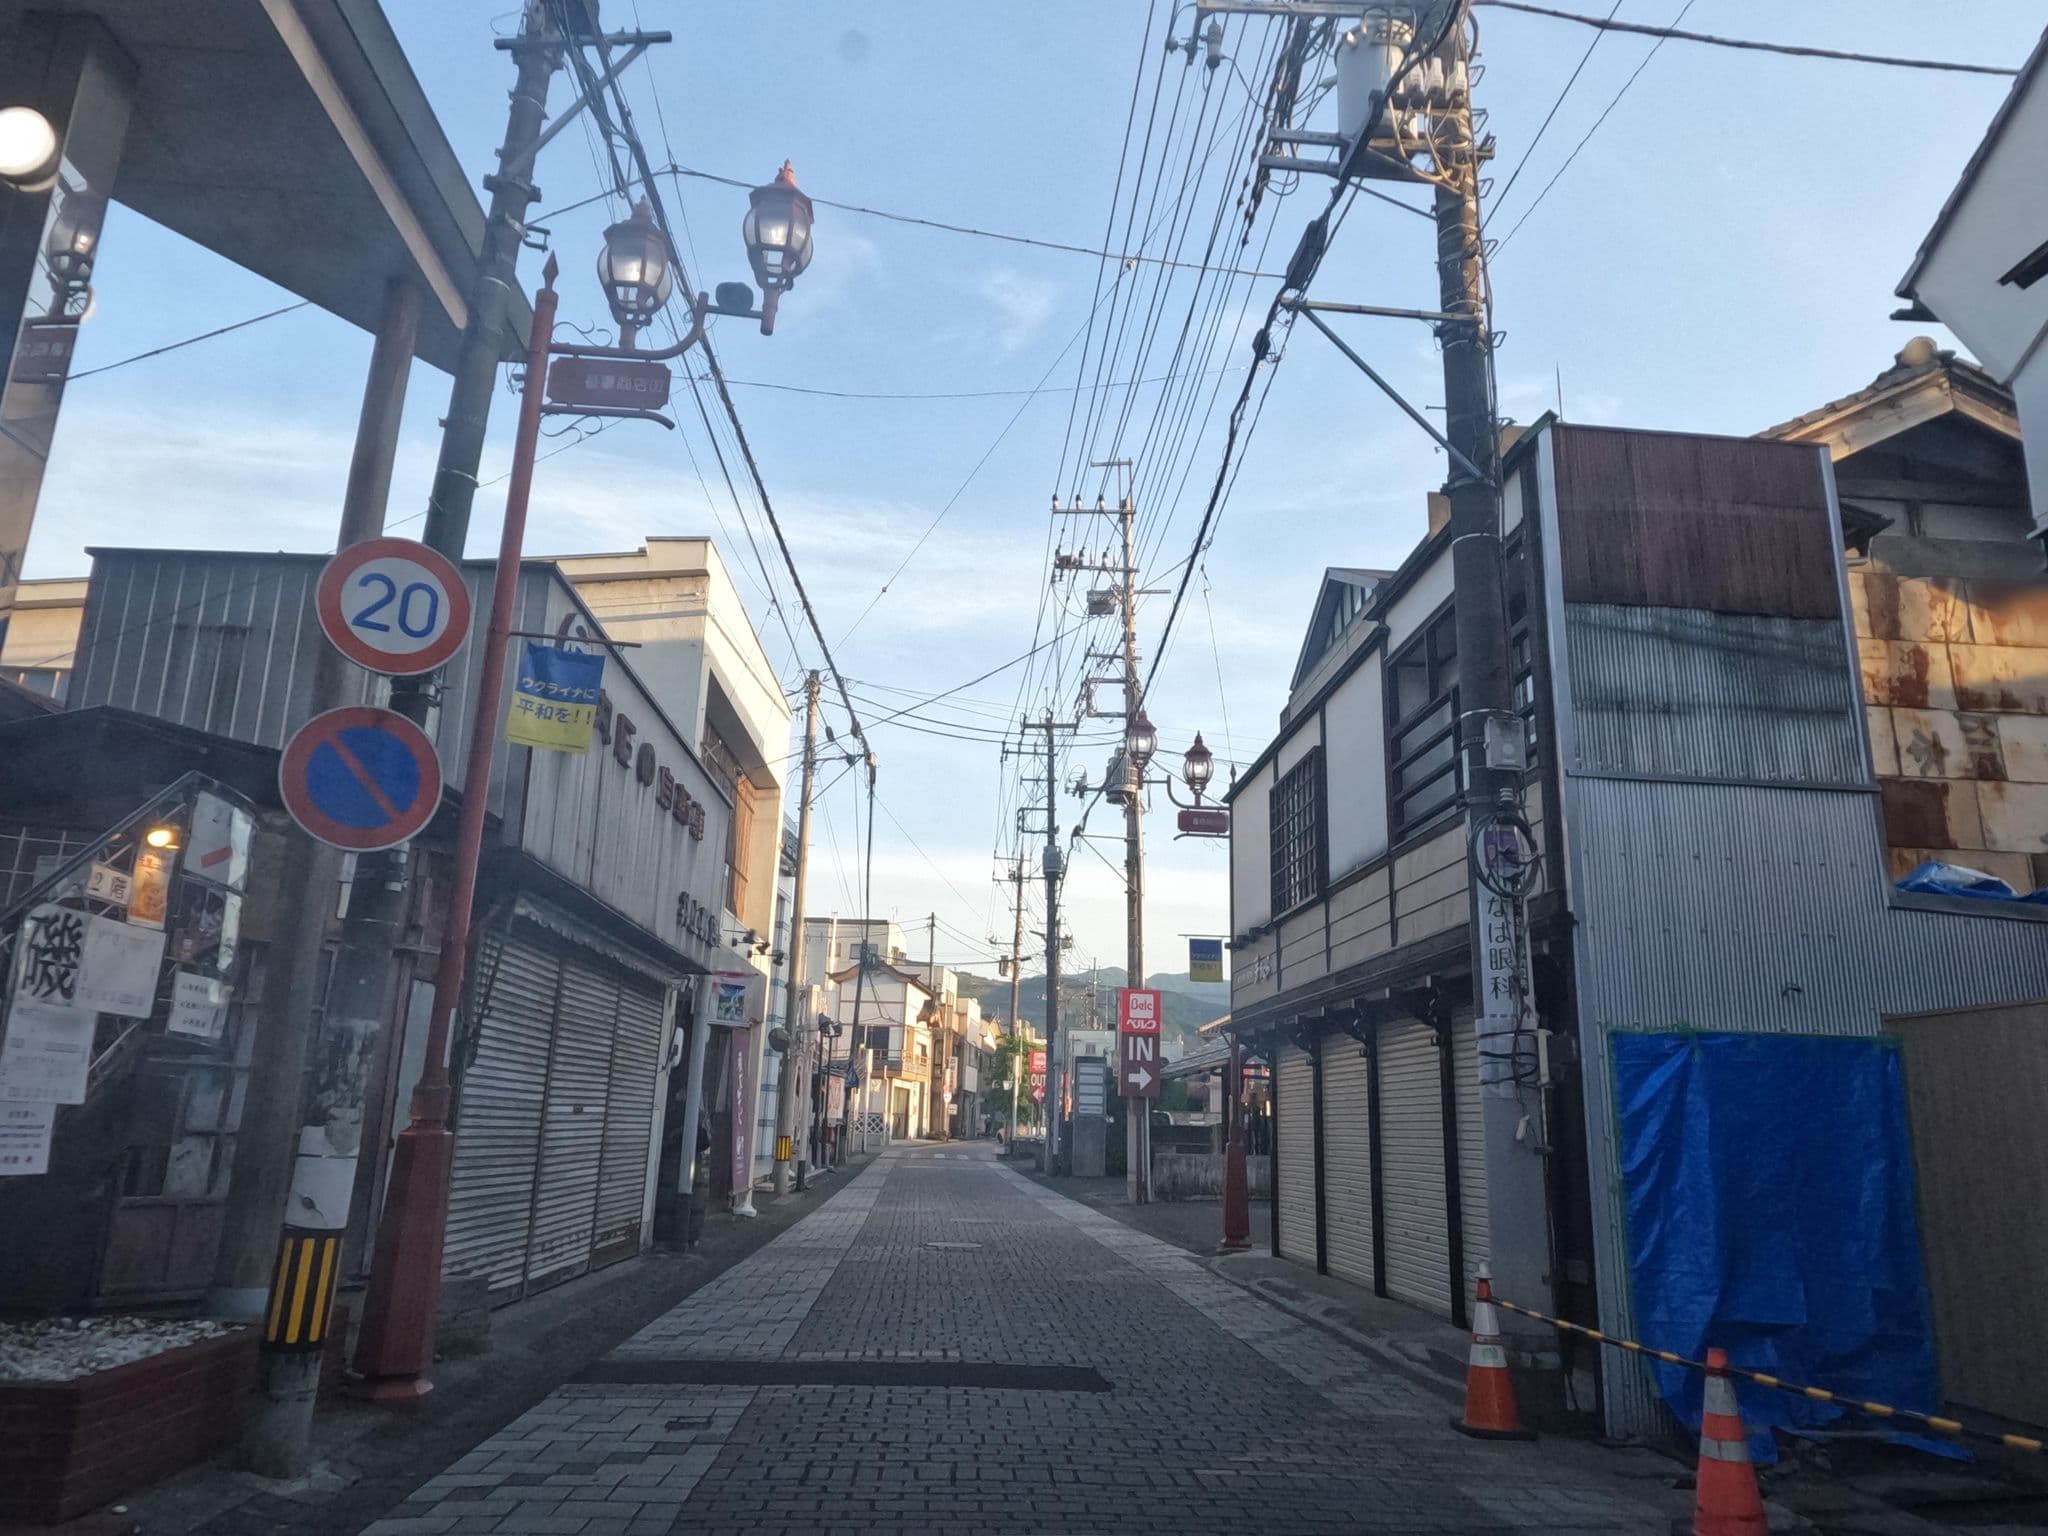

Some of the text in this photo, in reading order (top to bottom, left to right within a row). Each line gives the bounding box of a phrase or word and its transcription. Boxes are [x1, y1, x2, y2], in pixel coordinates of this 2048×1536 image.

[352, 573, 439, 637] 20
[522, 678, 596, 699] ウクライナに
[22, 913, 82, 1000] 磯
[1131, 998, 1153, 1011] Belc
[1128, 1036, 1153, 1061] IN
[1031, 1074, 1047, 1087] OUT
